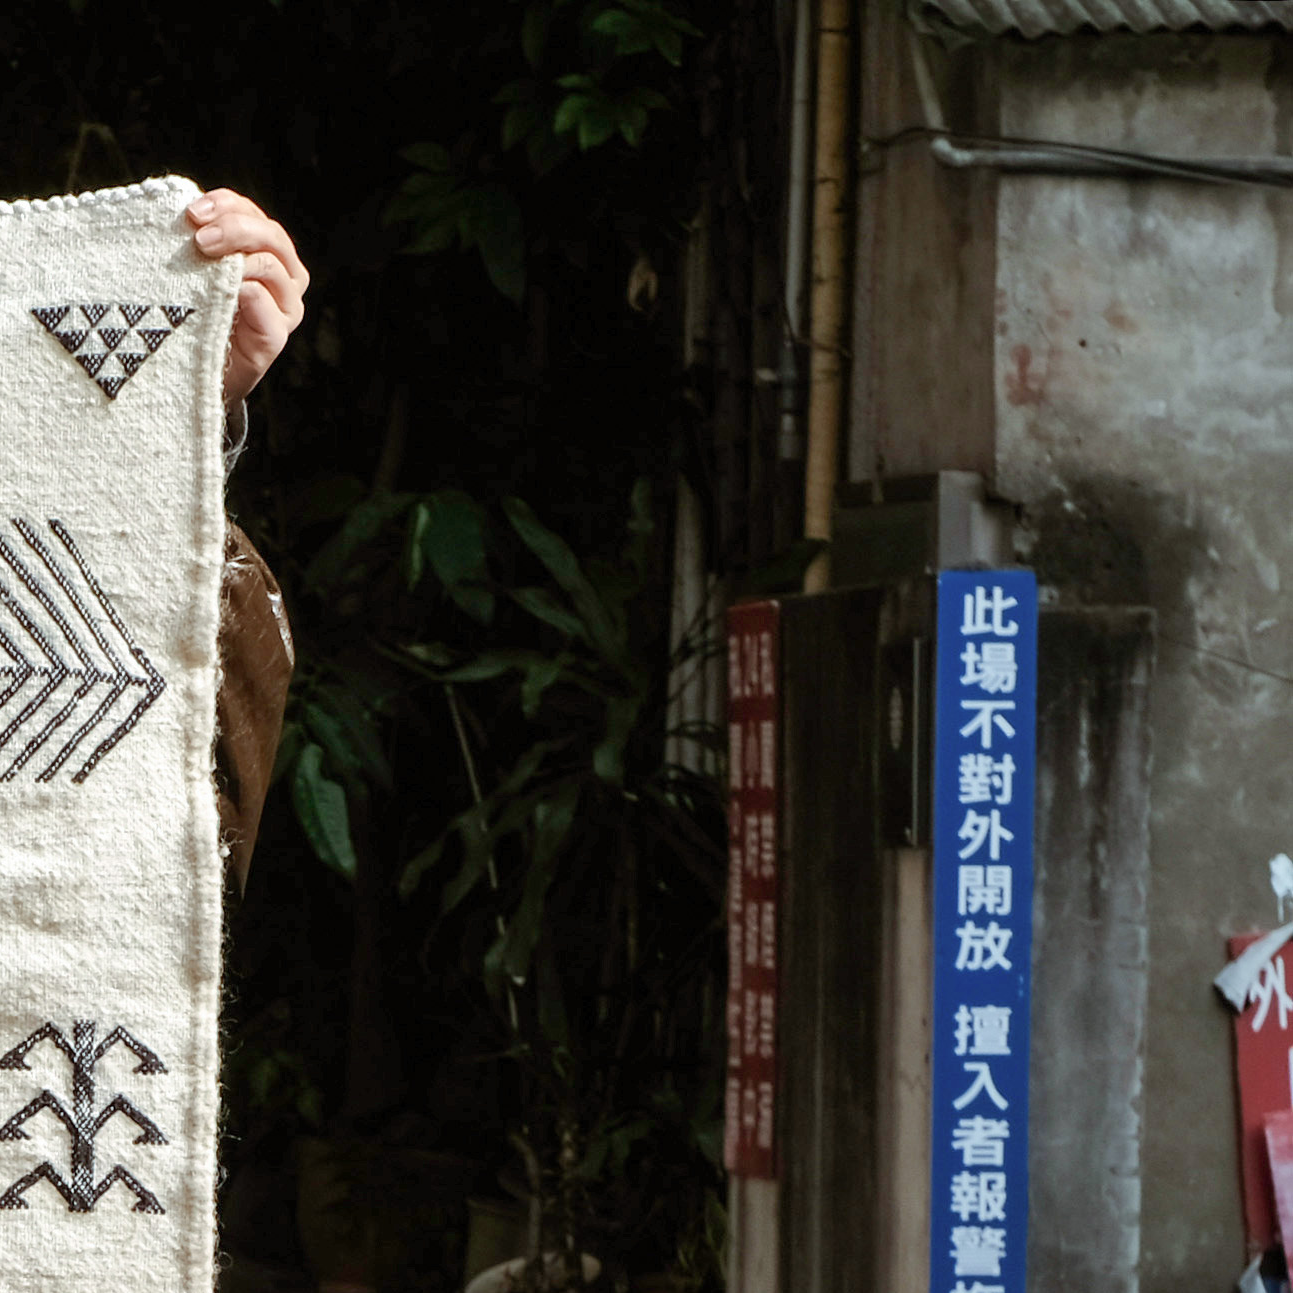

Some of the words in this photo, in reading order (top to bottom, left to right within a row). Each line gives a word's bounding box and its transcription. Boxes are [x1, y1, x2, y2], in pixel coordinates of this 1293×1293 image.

[955, 586, 1019, 972] 此場不對外開放
